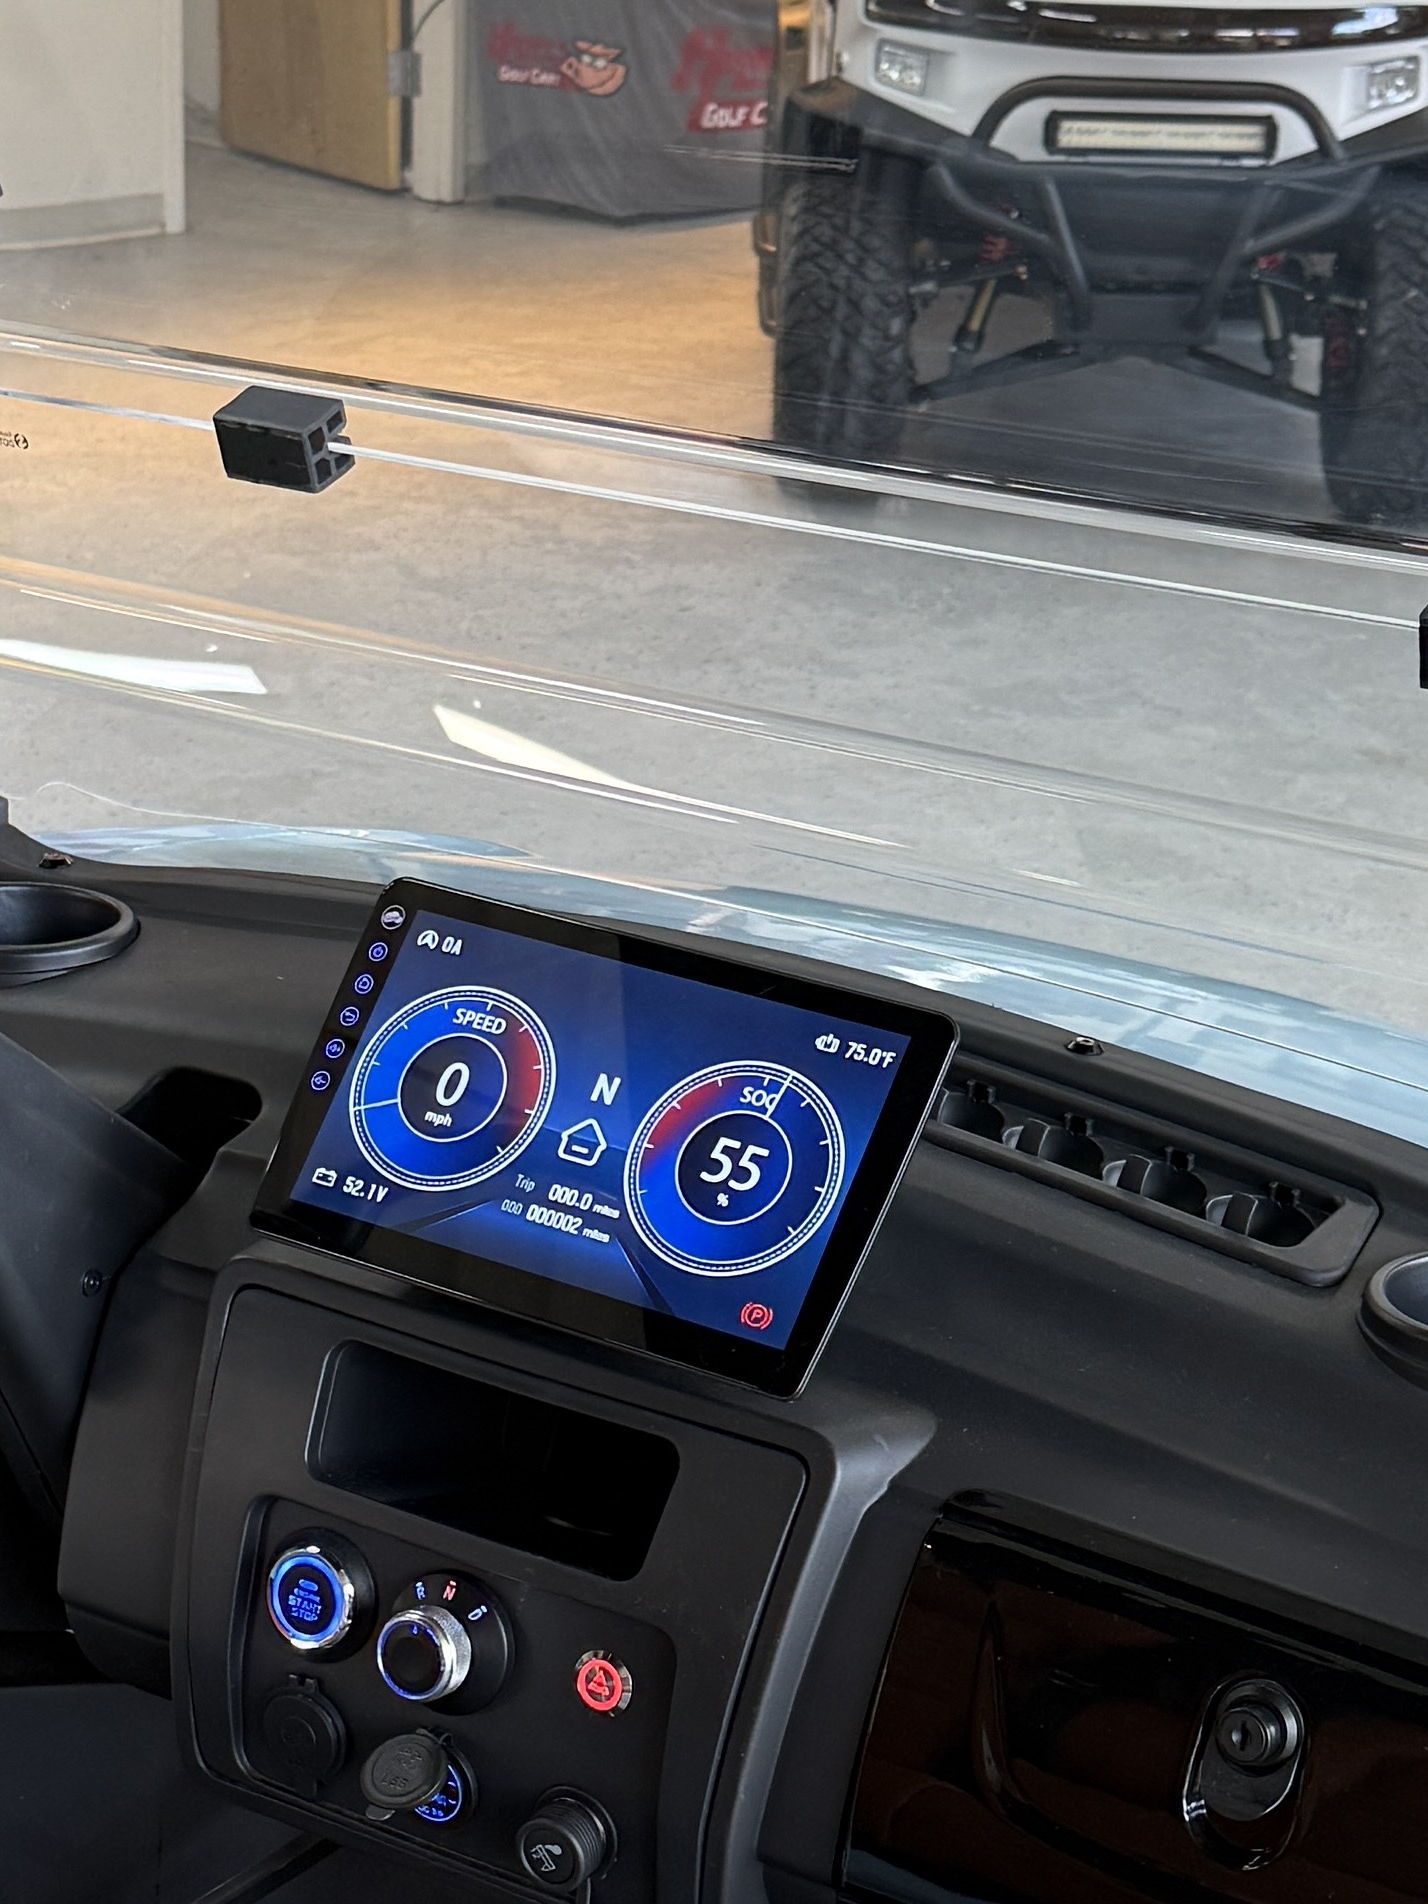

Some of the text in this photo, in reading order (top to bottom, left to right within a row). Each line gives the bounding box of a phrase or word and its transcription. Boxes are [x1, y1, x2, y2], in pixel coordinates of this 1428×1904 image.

[452, 1007, 507, 1035] SPEED
[435, 1062, 470, 1106] 0
[590, 1073, 621, 1106] N
[739, 1086, 779, 1111] SOC
[424, 1110, 453, 1127] mph
[700, 1137, 770, 1191] 55
[515, 1173, 536, 1194] Trip
[548, 1184, 593, 1211] 000.0
[526, 1204, 583, 1235] 000002
[288, 1595, 322, 1614] START
[442, 1586, 456, 1601] N
[291, 1607, 319, 1622] STOP
